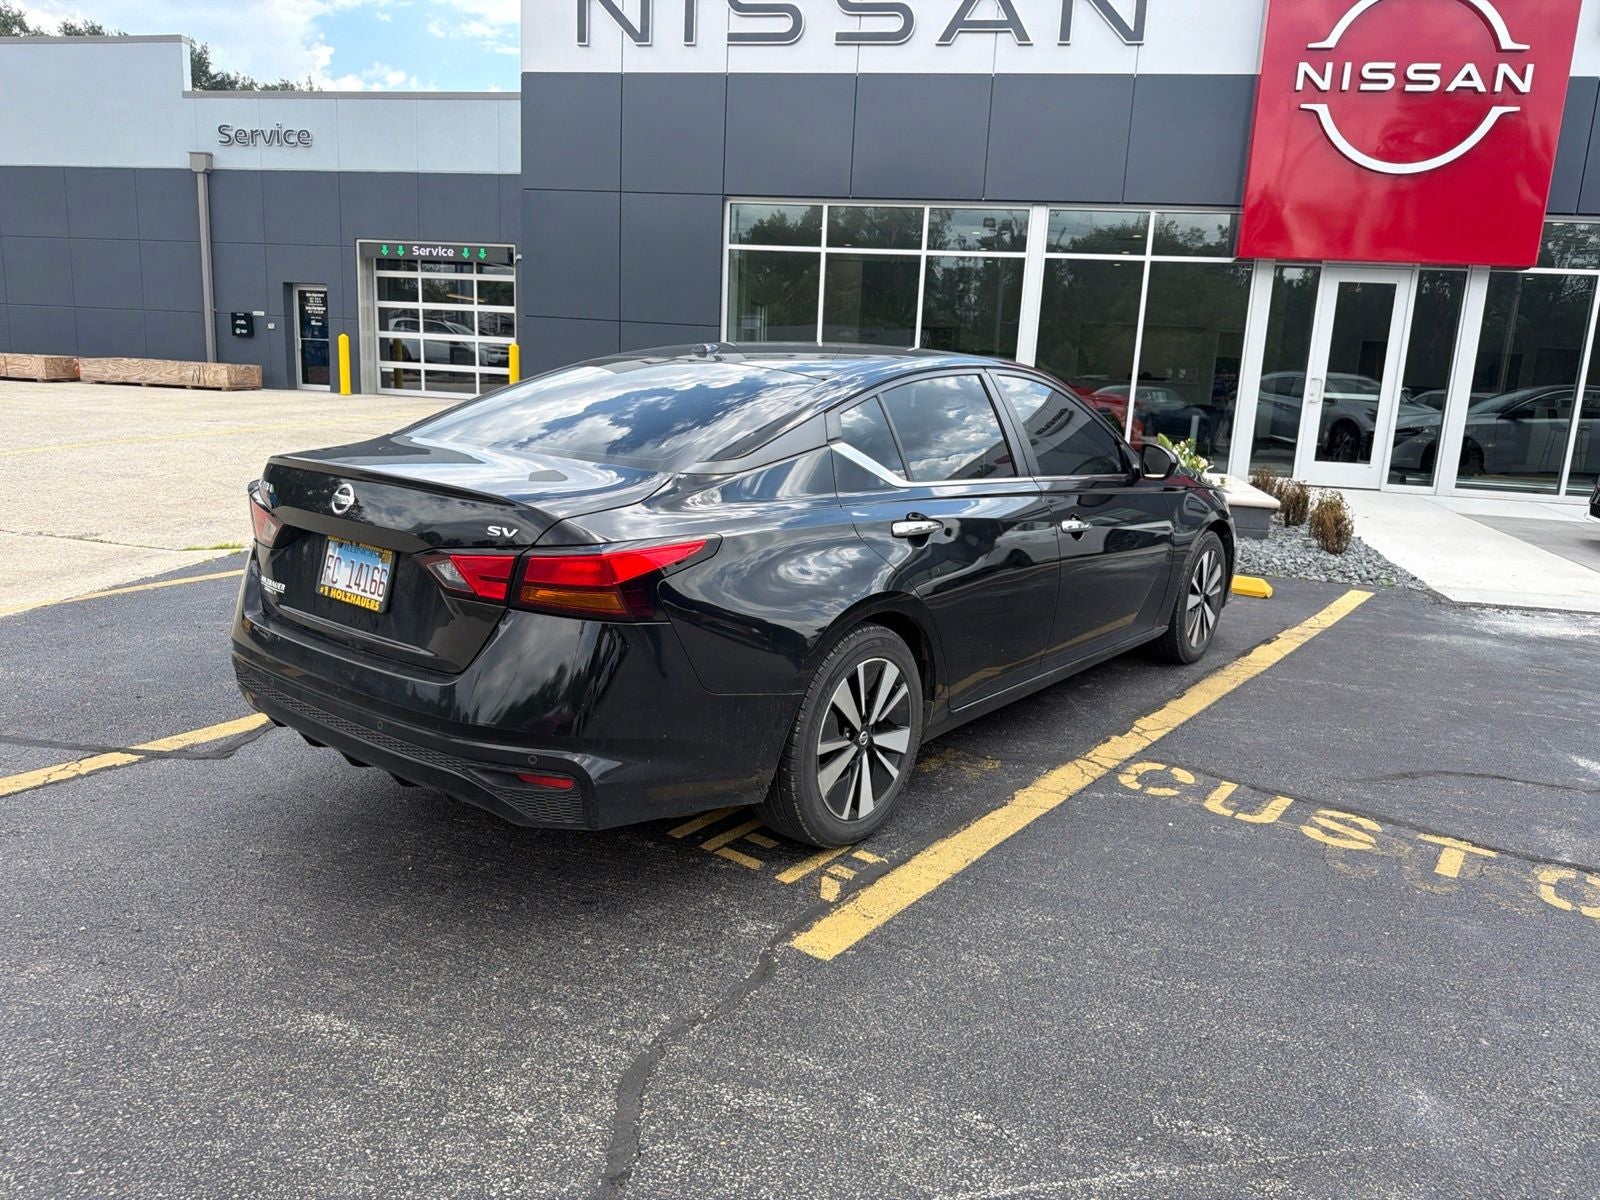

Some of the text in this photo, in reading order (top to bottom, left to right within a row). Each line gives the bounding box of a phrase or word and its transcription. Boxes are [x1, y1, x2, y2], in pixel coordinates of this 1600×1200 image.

[577, 0, 1146, 46] NISSAN
[1294, 61, 1535, 93] NISSAN
[217, 122, 313, 147] Service
[412, 245, 455, 257] Service
[486, 525, 520, 538] SV
[323, 554, 389, 598] FC 14166
[330, 587, 381, 612] HOLZHAUERS
[1117, 762, 1600, 920] CUSTO
